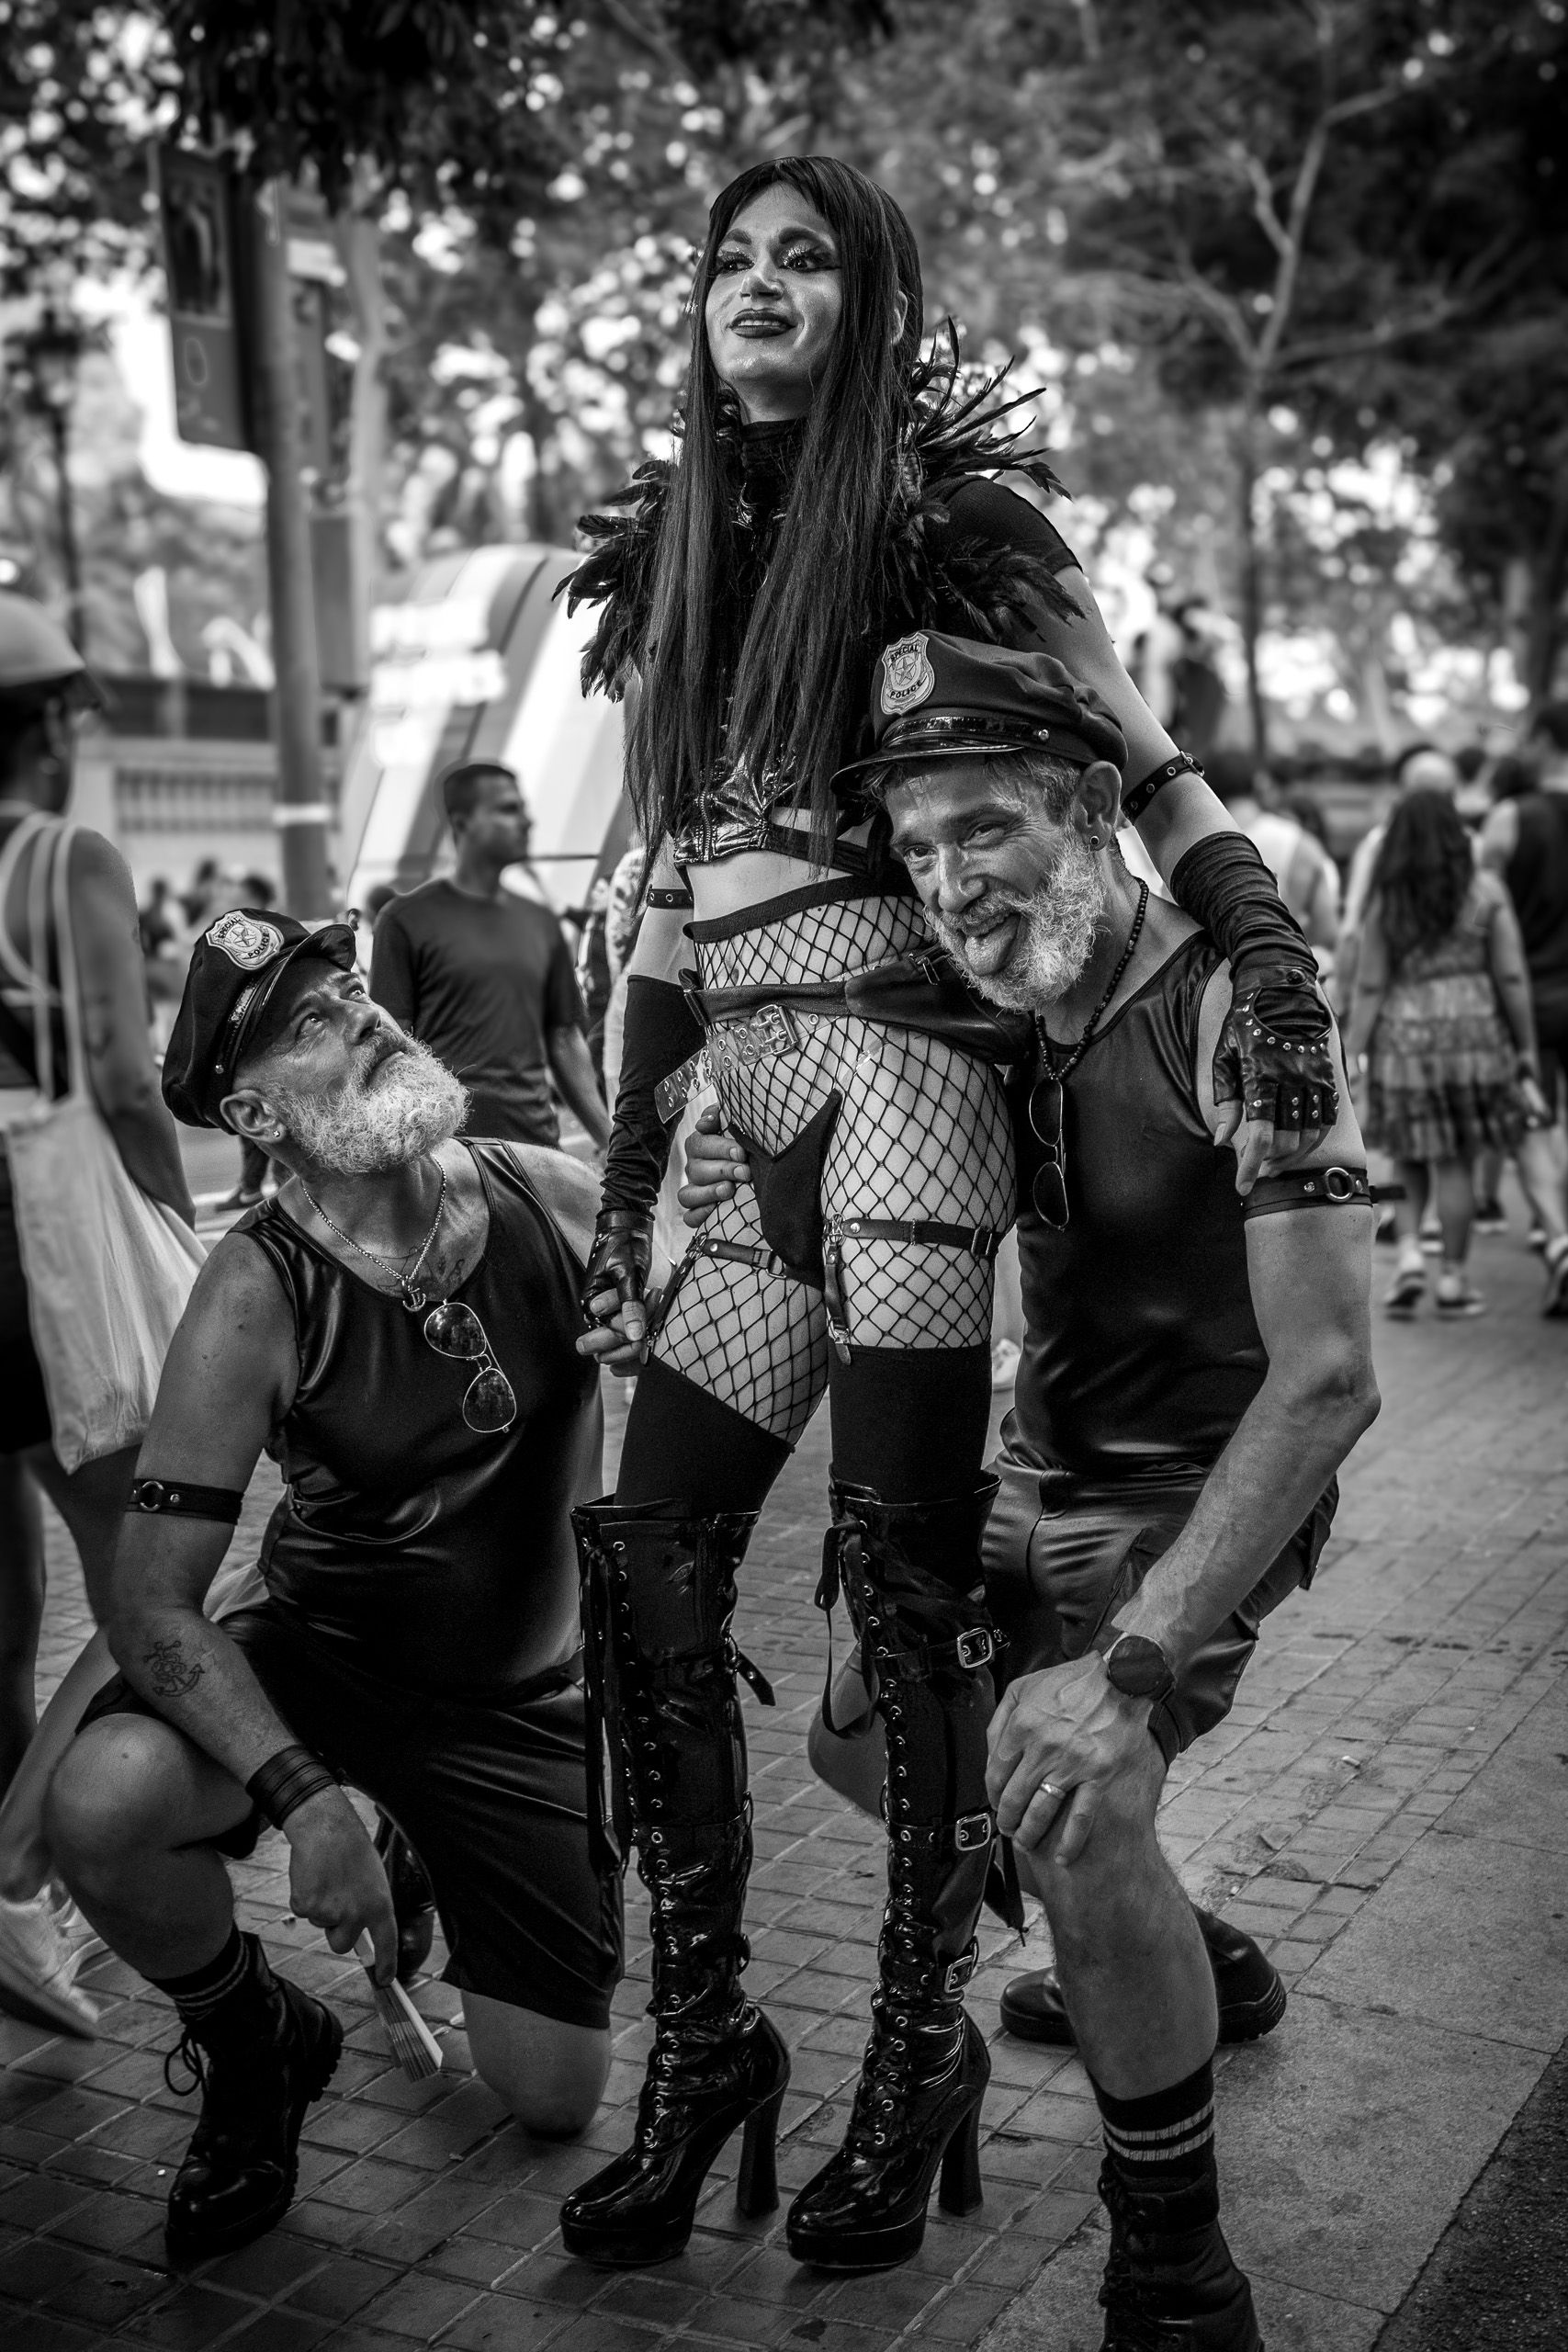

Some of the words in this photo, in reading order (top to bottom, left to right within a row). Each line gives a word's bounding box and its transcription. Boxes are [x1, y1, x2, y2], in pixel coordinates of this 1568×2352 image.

[890, 644, 919, 662] SPECIAL
[890, 680, 923, 699] POLICE
[218, 917, 242, 939] SPECIAL
[248, 933, 270, 958] POLICE
